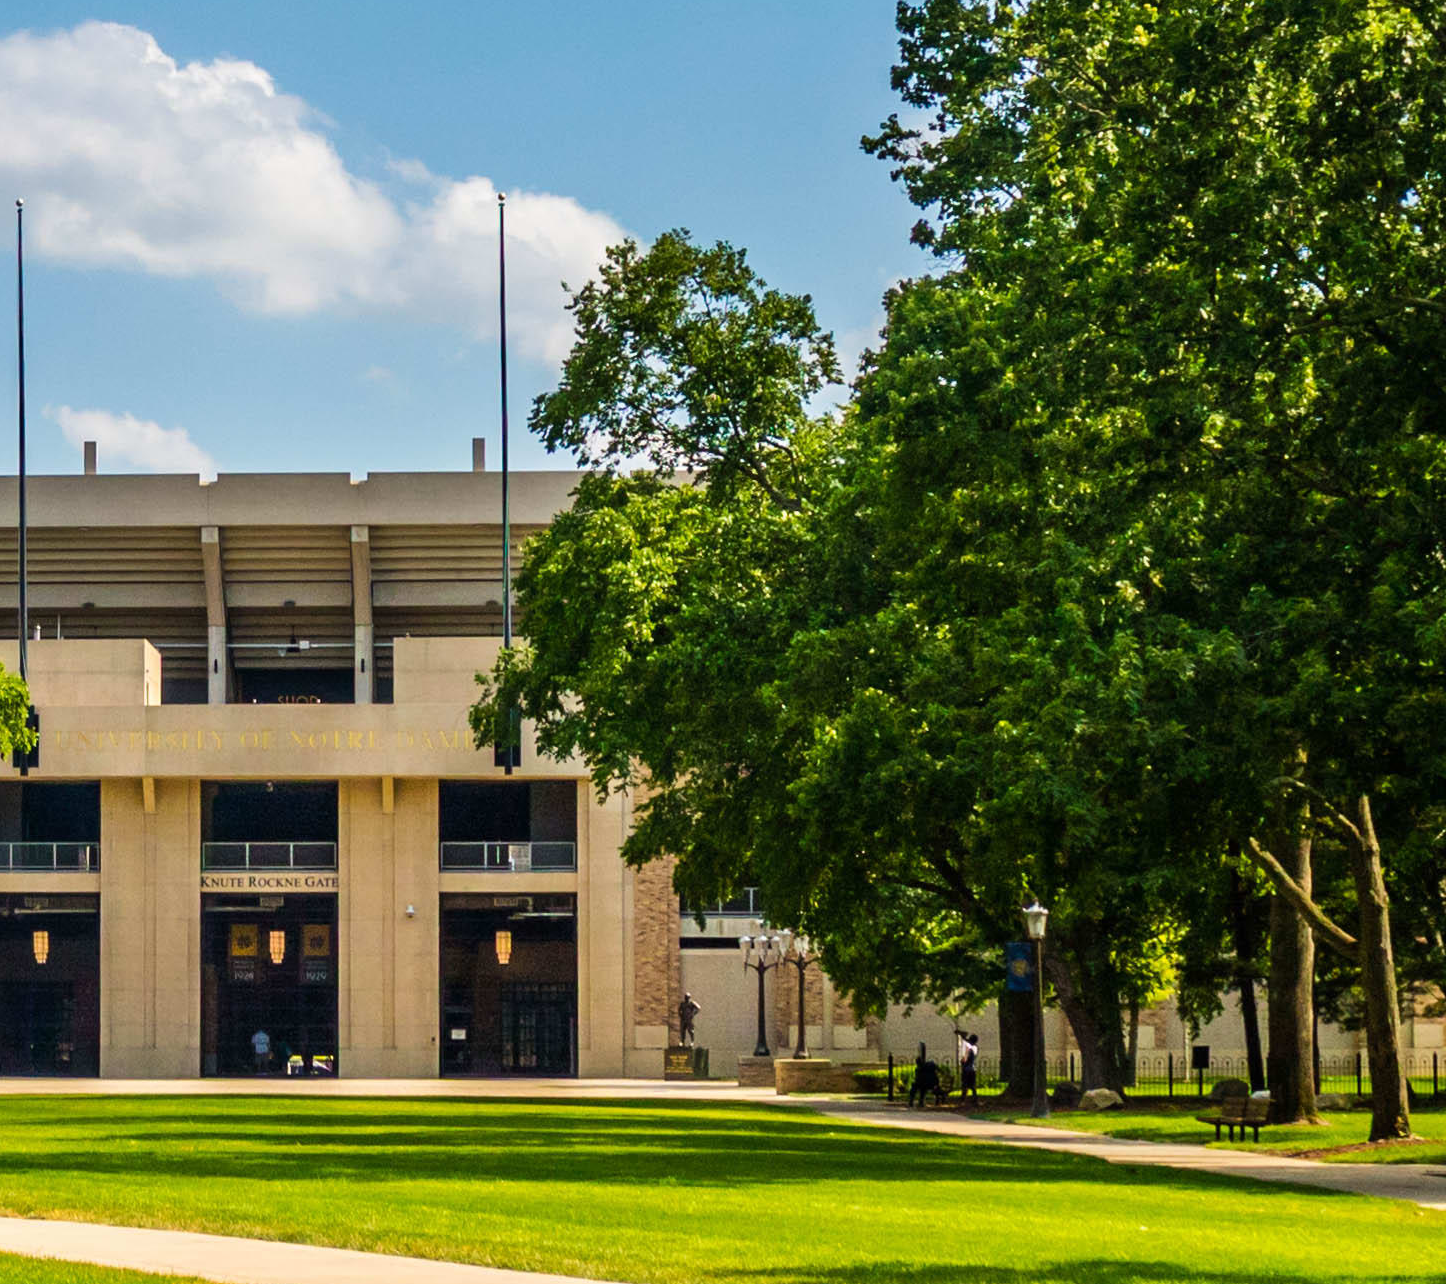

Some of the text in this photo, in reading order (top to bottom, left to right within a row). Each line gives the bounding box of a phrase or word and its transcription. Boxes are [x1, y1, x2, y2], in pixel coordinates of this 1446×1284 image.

[56, 730, 223, 750] UNIVERSITY
[240, 729, 273, 750] OF
[291, 730, 378, 750] NOTRE
[200, 876, 339, 888] KNUTE ROCKNE GATE
